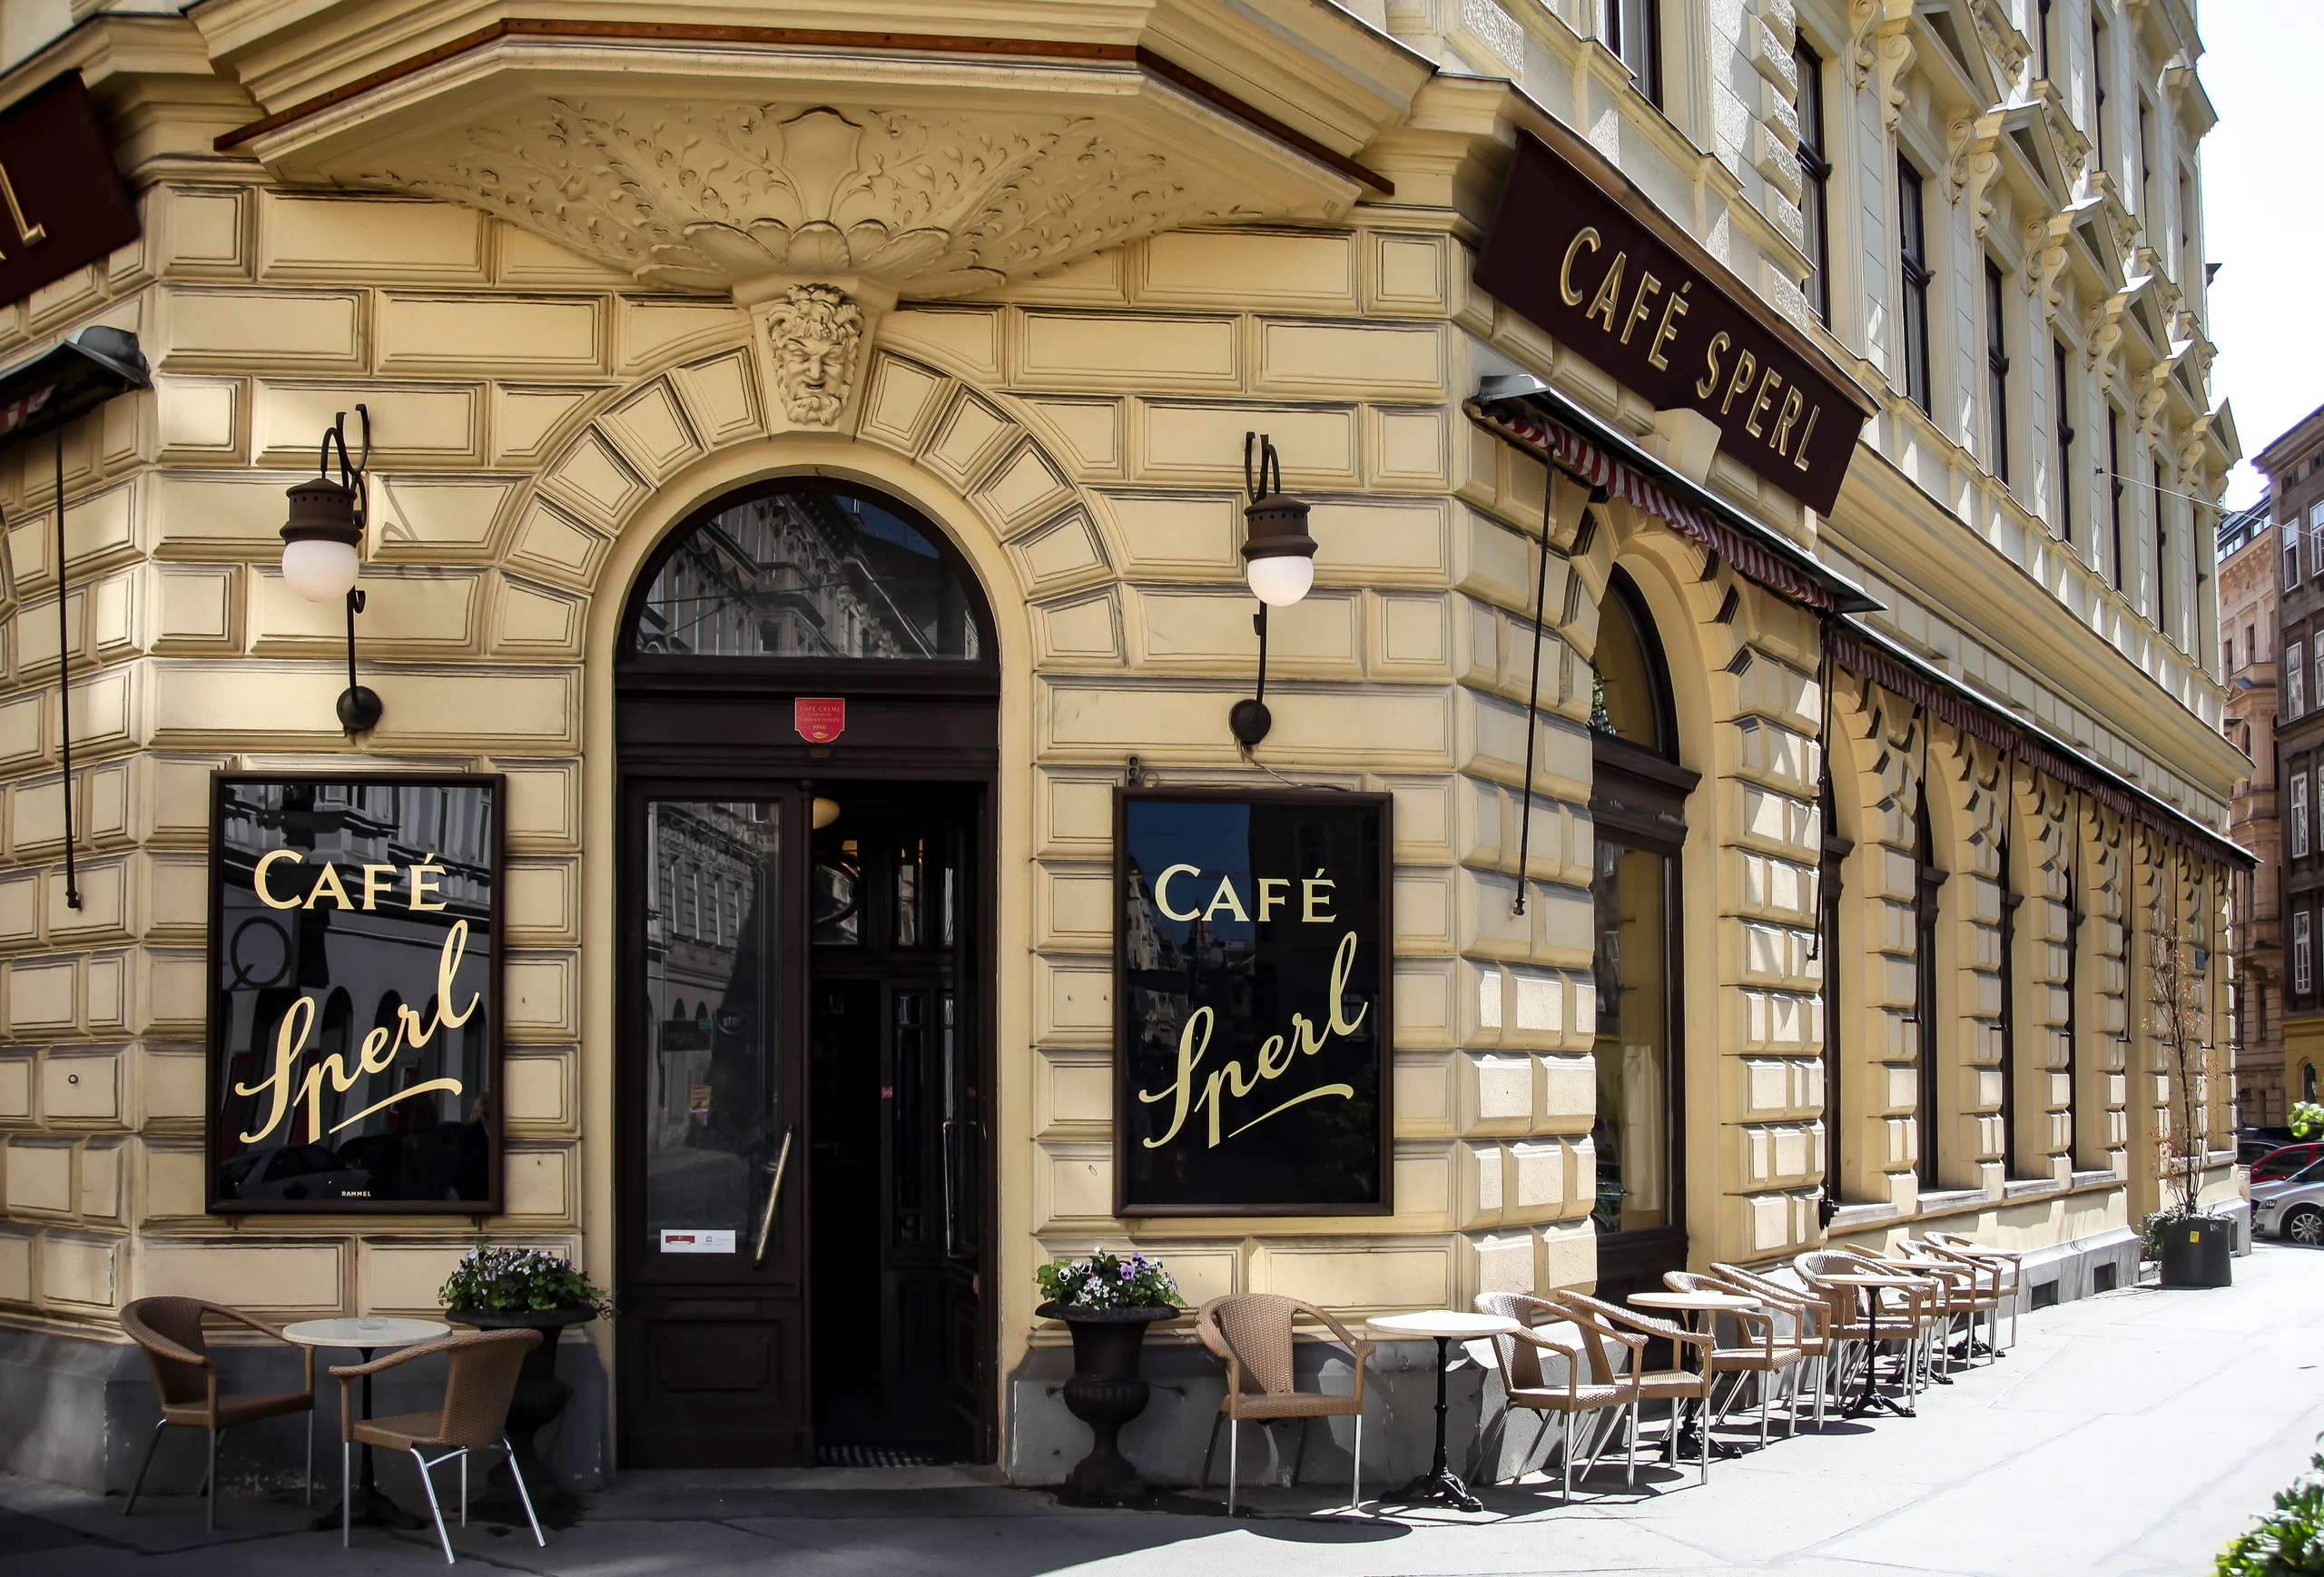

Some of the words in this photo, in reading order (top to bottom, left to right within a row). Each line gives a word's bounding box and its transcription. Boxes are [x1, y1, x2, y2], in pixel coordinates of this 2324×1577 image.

[1560, 226, 1692, 372] CAFÉ
[1696, 331, 1820, 472] SPERL
[253, 849, 448, 911] CAFÉ
[1155, 864, 1337, 922] CAFÉ
[234, 919, 480, 1145] Sperl
[1138, 931, 1368, 1148] Sperl
